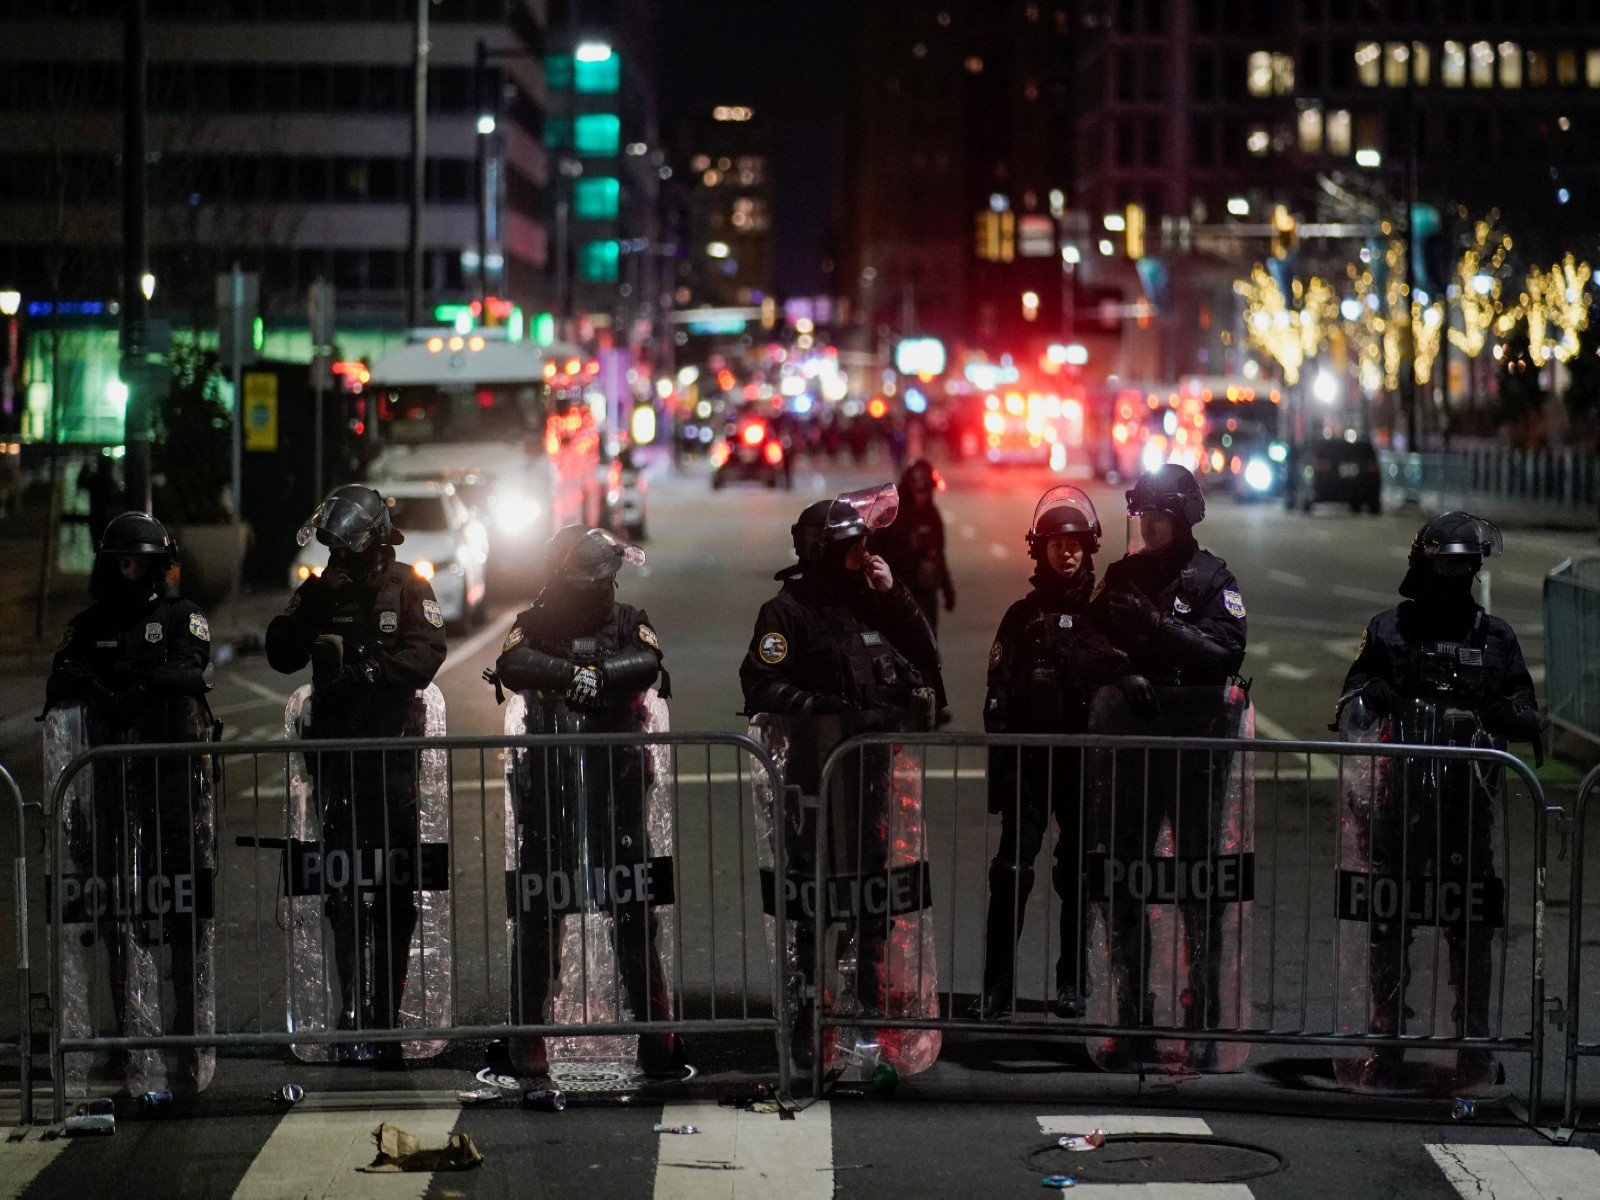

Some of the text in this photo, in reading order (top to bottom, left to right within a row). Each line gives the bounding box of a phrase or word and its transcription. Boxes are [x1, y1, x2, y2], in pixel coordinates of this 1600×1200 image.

[302, 848, 433, 889] POLICE
[521, 862, 655, 912] POLICE
[1103, 857, 1237, 900] POLICE
[61, 874, 194, 918] POLICE
[1349, 876, 1485, 922] POLICE
